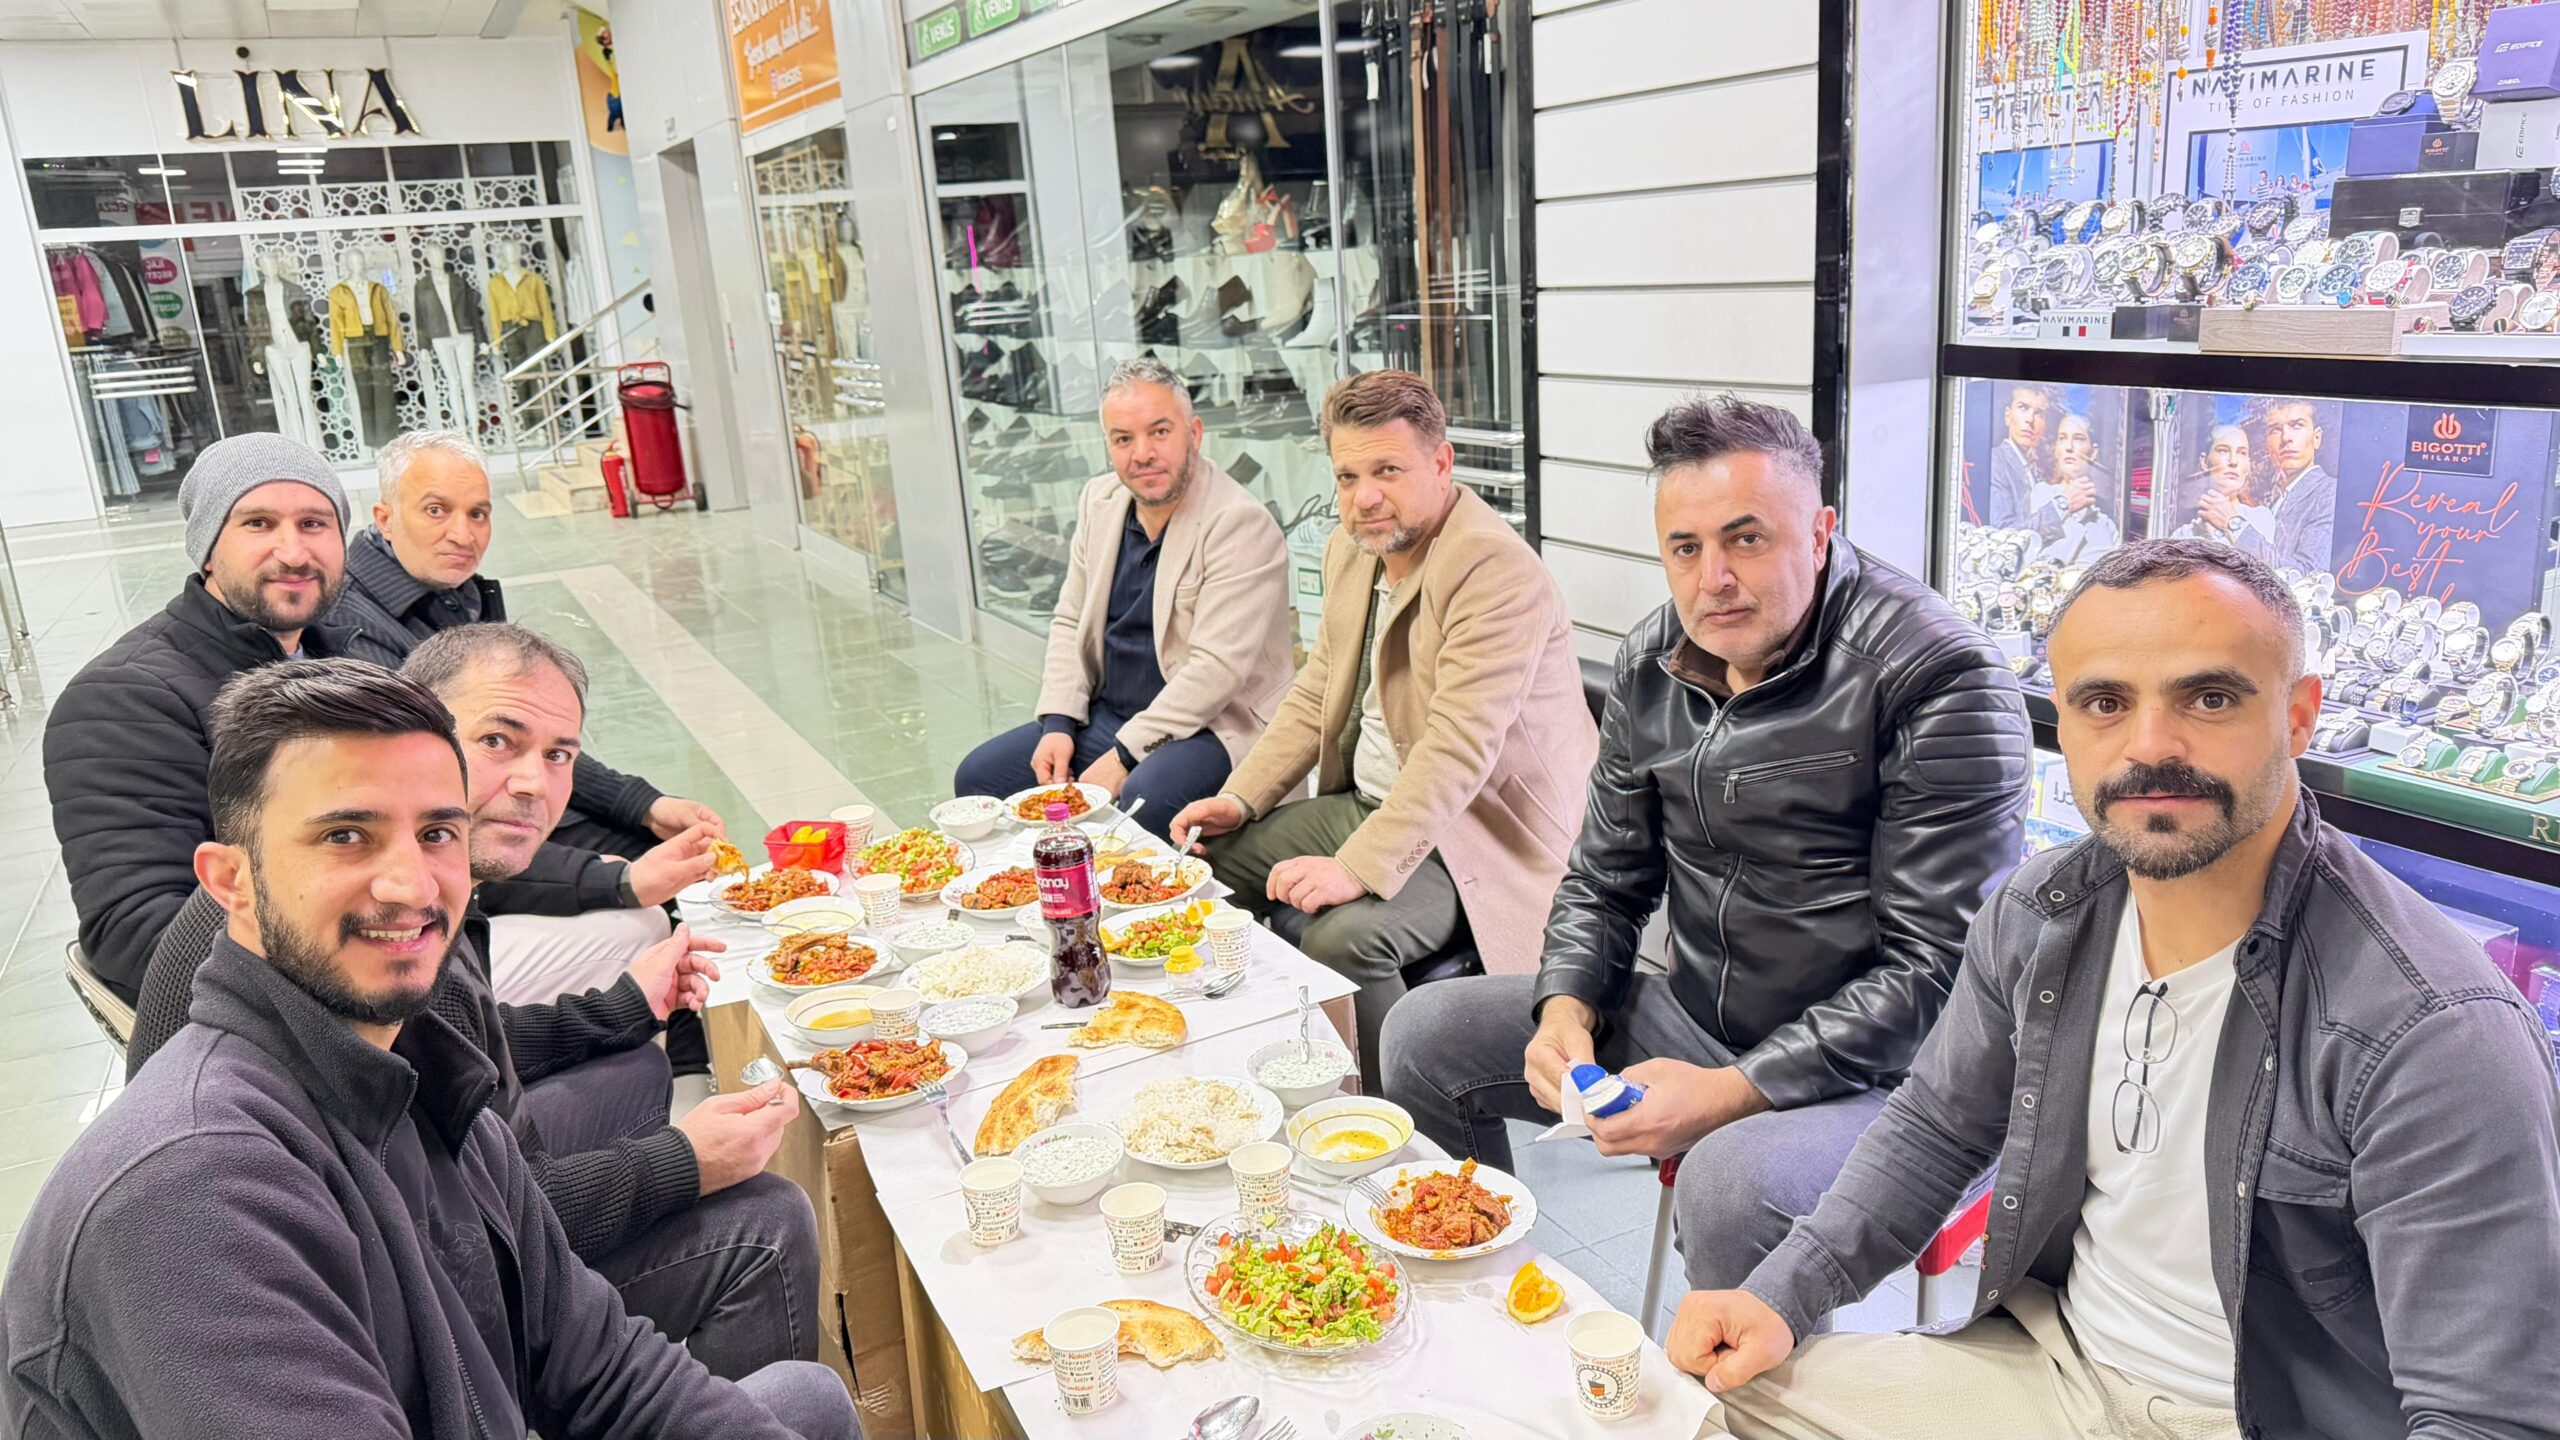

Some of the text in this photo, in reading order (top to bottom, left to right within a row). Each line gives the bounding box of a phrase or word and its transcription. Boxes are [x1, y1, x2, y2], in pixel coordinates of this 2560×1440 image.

[2209, 89, 2355, 113] TIE OF FASHION
[2043, 315, 2108, 325] NAVIMARINE
[2357, 460, 2519, 532] Reveal
[2417, 520, 2500, 557] your
[2336, 527, 2465, 596] Best
